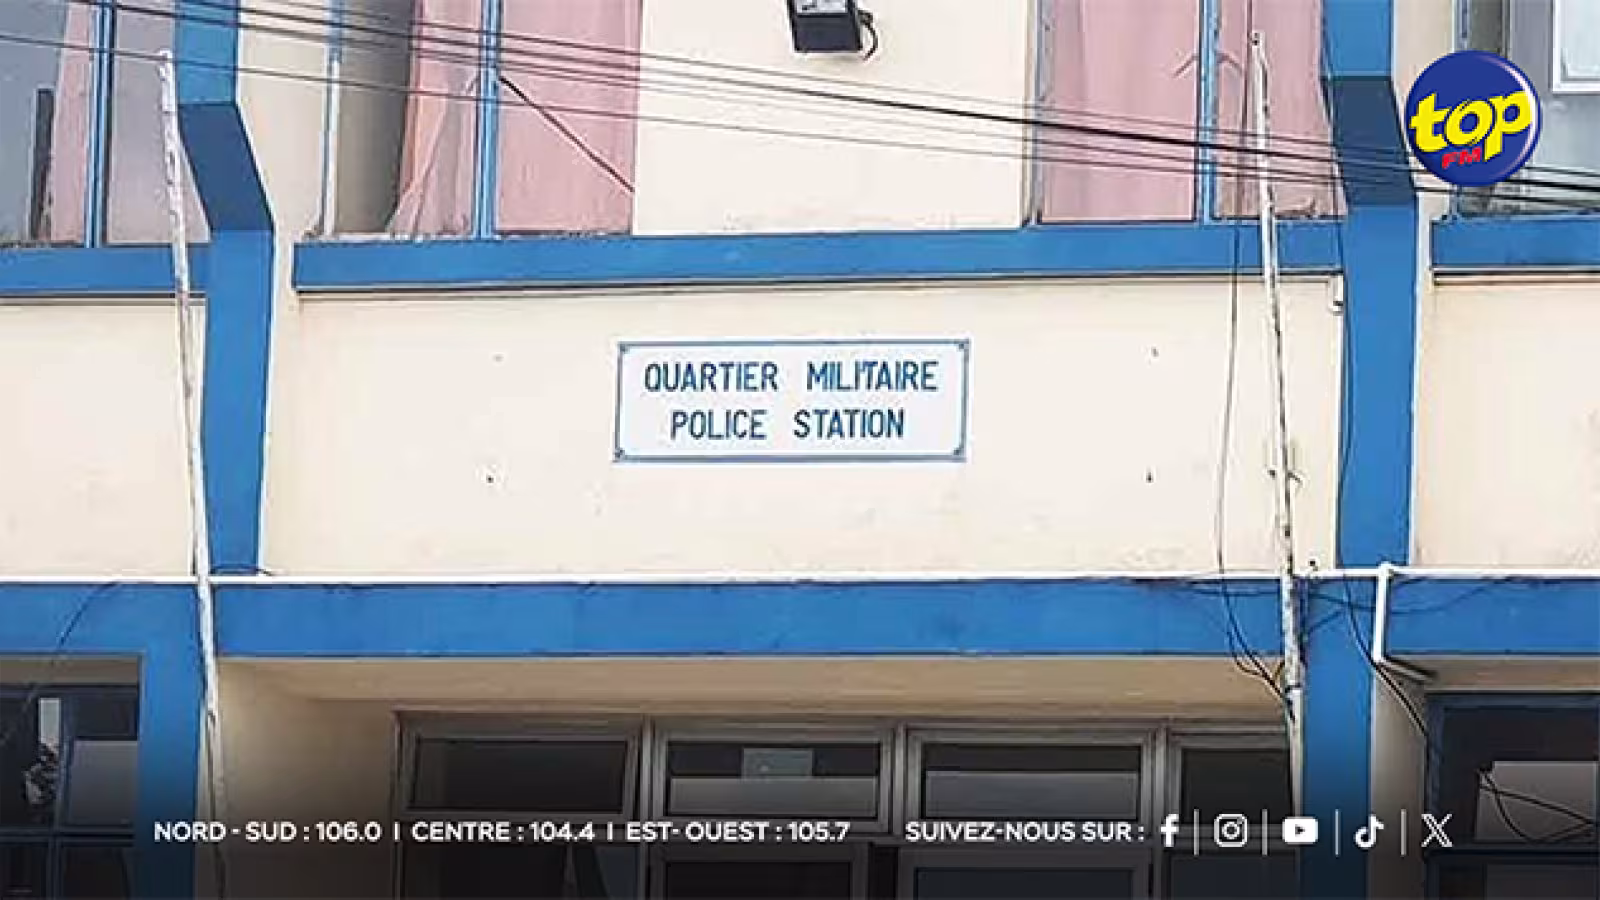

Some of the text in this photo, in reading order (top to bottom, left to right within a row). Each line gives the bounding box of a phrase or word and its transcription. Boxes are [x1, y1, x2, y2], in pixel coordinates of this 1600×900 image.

[644, 360, 939, 392] QUARTIER MILITAIRE
[670, 407, 904, 440] POLICE STATION
